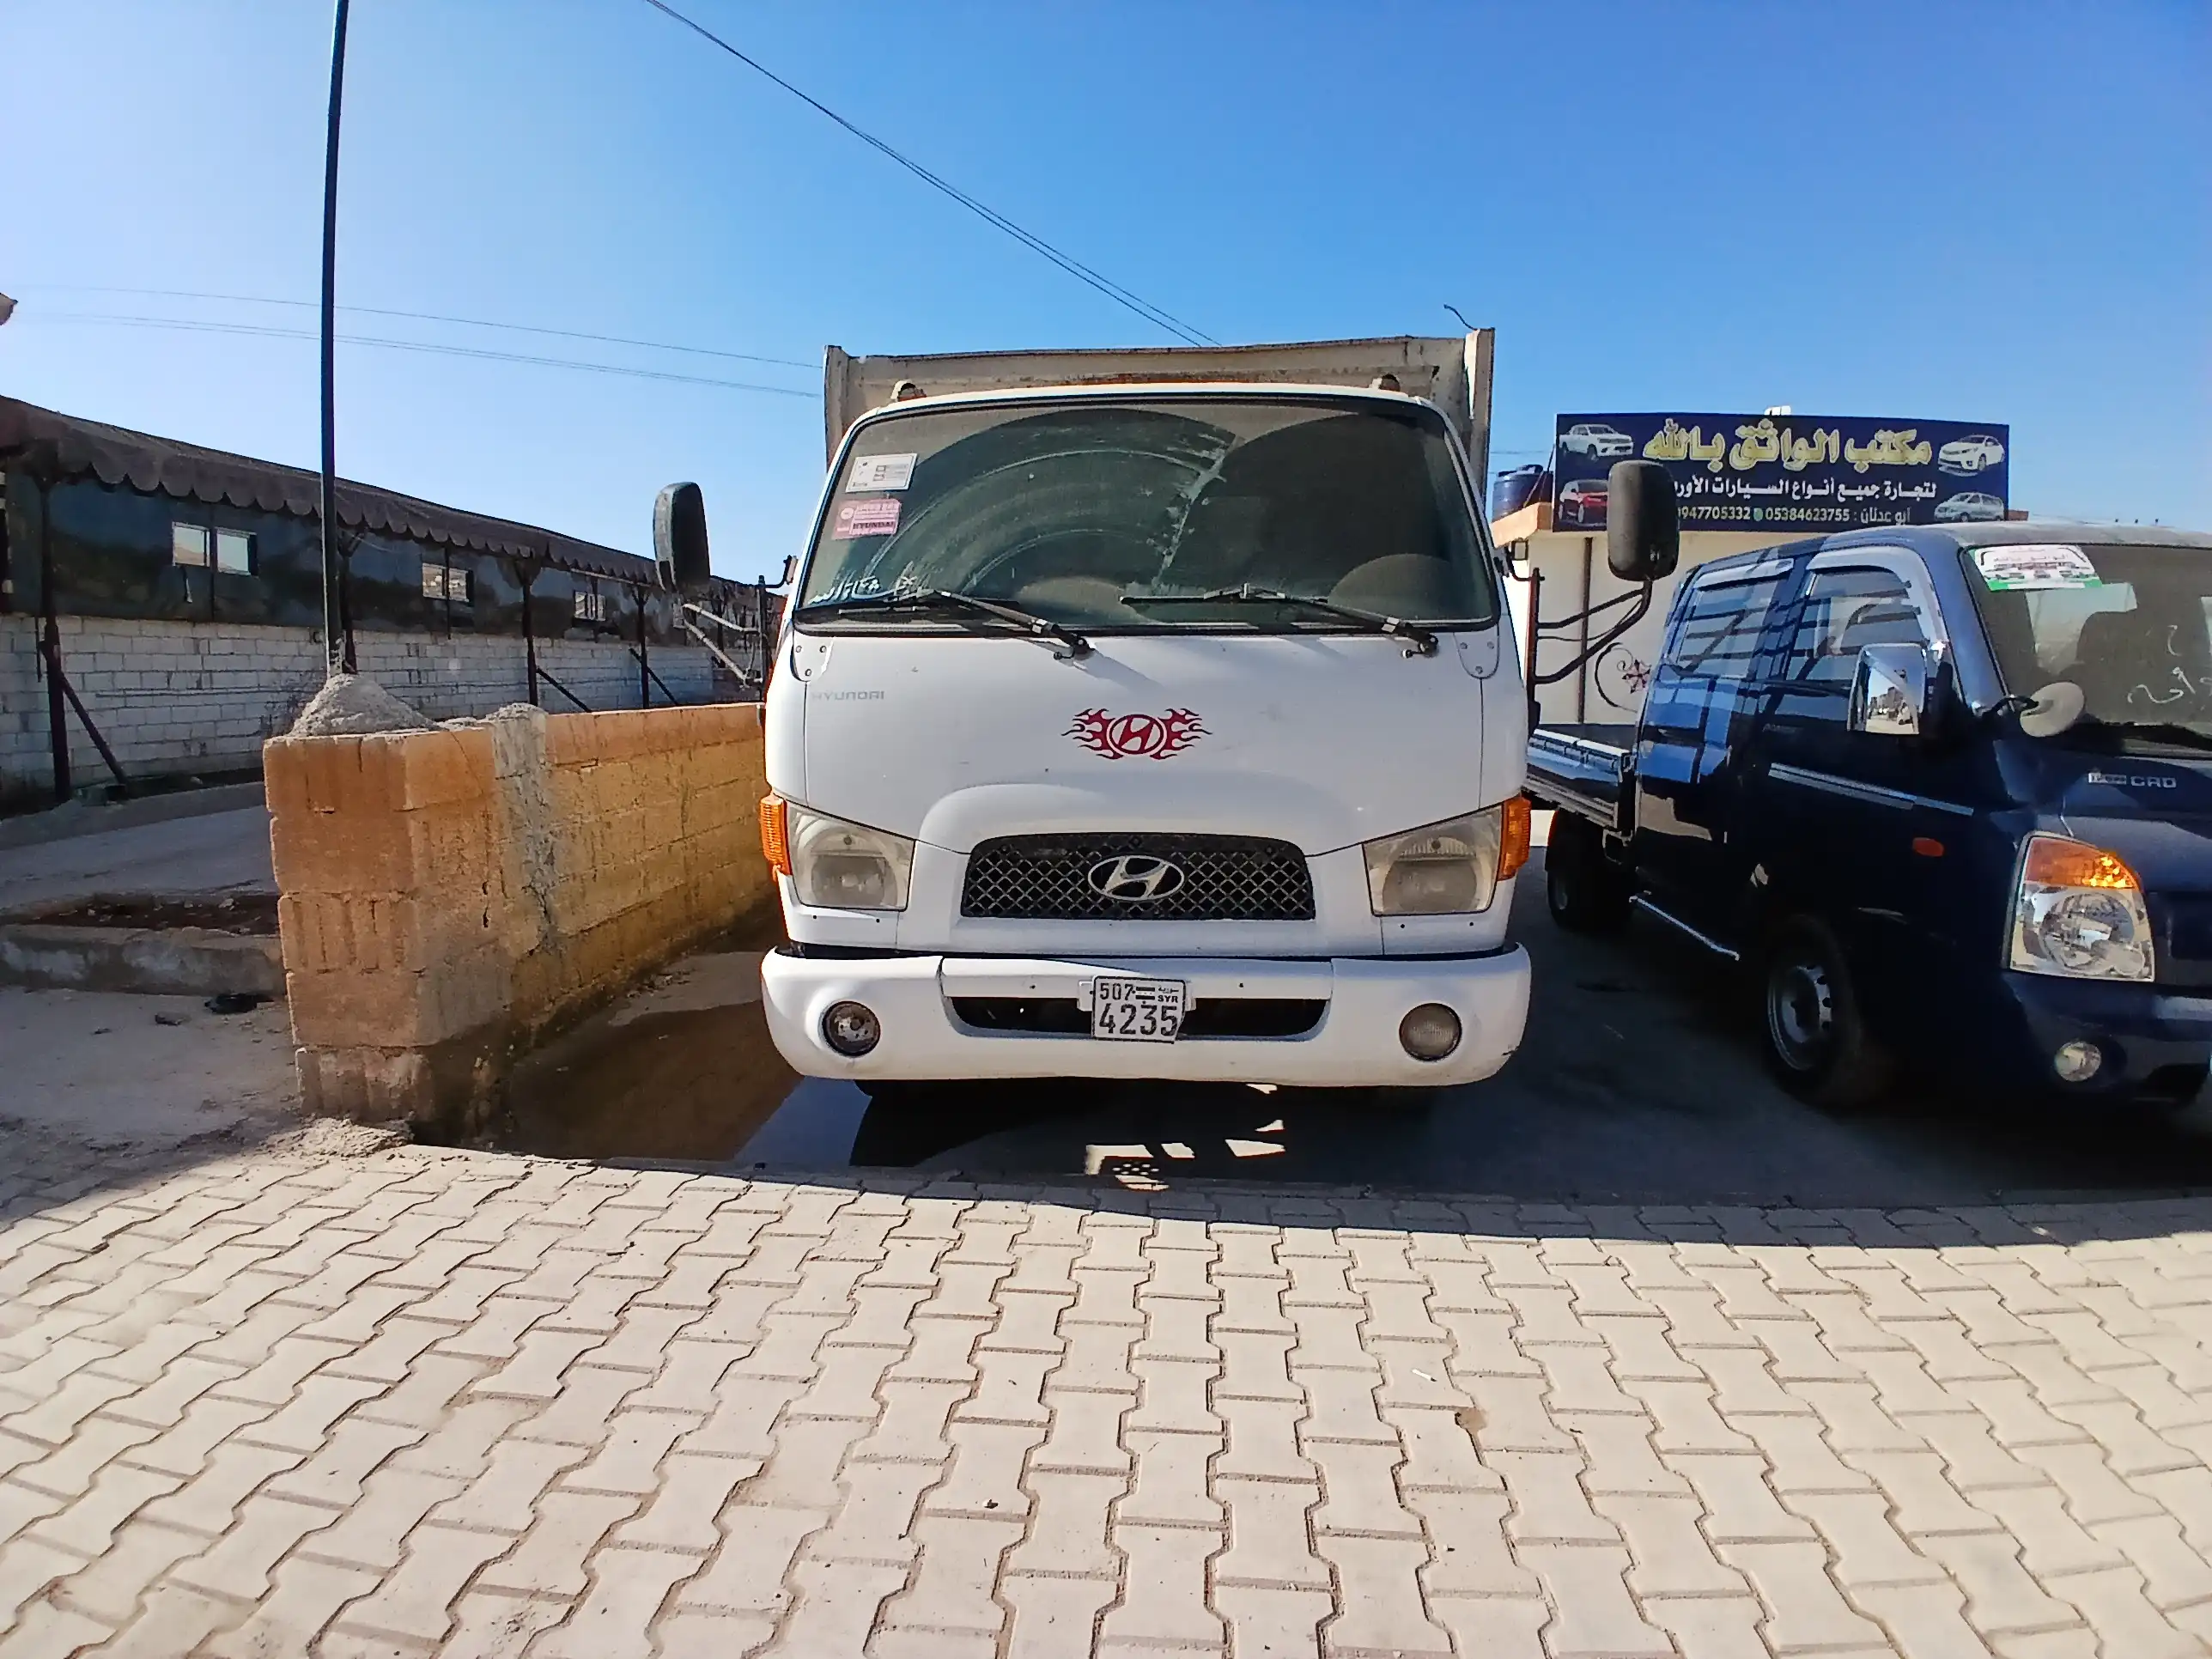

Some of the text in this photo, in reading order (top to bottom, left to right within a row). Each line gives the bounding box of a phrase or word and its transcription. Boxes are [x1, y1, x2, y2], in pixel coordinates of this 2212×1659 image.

[1643, 418, 1725, 472] بالله
[1844, 428, 1932, 473] مكتب
[1711, 477, 1789, 499] السيارات
[1791, 477, 1835, 501] أنواع
[1837, 483, 1881, 502] جميع
[1883, 480, 1937, 501] لتجارة
[811, 690, 885, 701] HYUNDAI
[1100, 982, 1133, 1000] 507
[1158, 994, 1178, 1003] SYR
[1099, 1003, 1177, 1036] 4235
